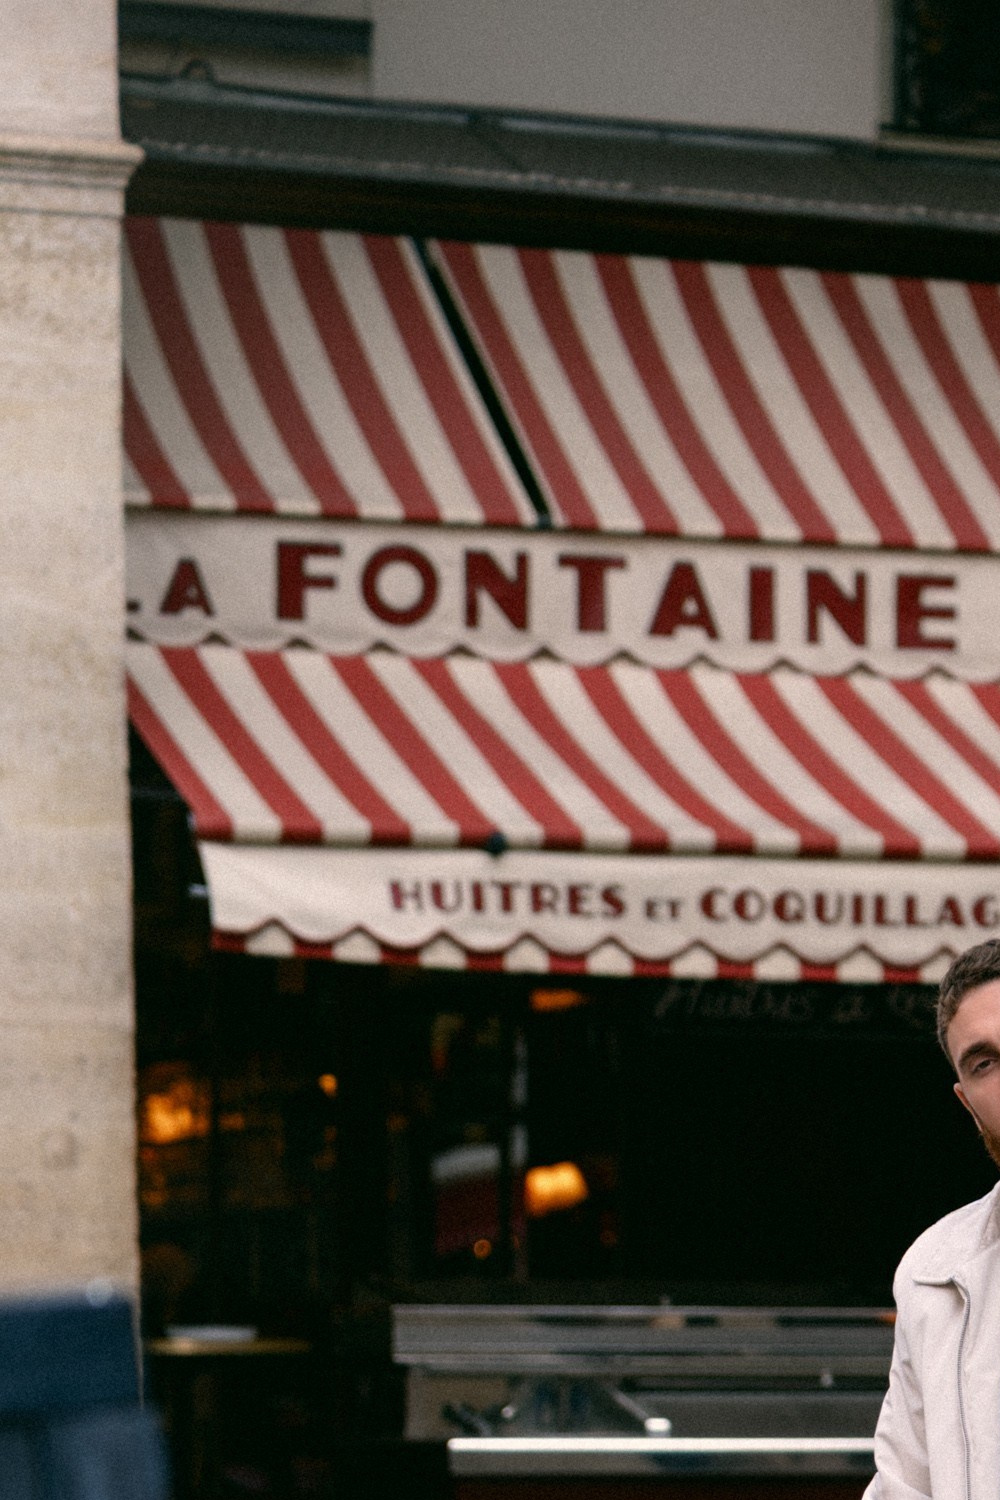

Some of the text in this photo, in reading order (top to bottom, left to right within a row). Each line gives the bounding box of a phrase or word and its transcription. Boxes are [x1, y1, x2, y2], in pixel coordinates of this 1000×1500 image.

[126, 557, 215, 618] A
[274, 538, 957, 653] FONTAINE
[389, 880, 627, 919] HUITRES
[643, 897, 682, 921] ET
